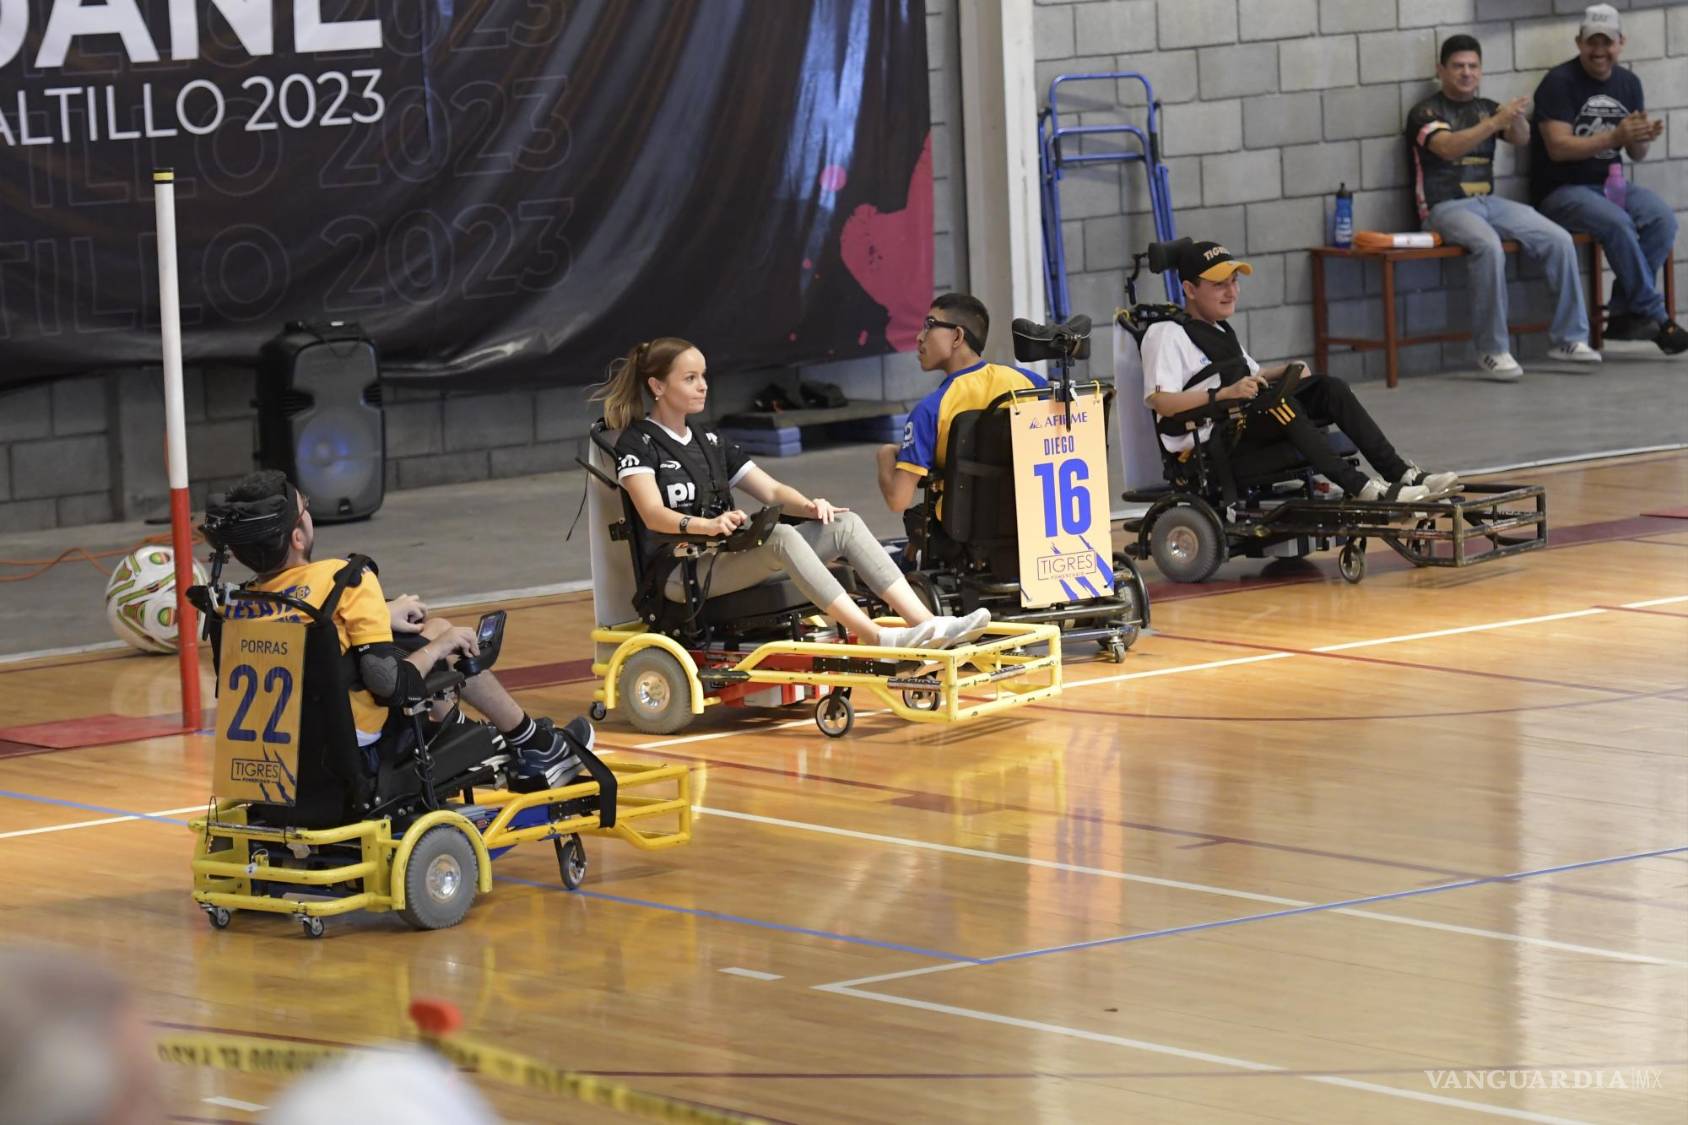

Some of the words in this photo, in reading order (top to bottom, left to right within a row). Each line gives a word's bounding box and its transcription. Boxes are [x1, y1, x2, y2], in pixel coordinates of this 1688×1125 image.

[241, 69, 386, 132] 2023
[320, 197, 575, 313] 2023
[1044, 435, 1074, 455] DIEGO
[1034, 458, 1091, 538] 16
[1041, 554, 1092, 574] TIGRES
[240, 639, 288, 656] PORRAS
[226, 664, 293, 744] 22
[235, 761, 278, 778] TIGRES
